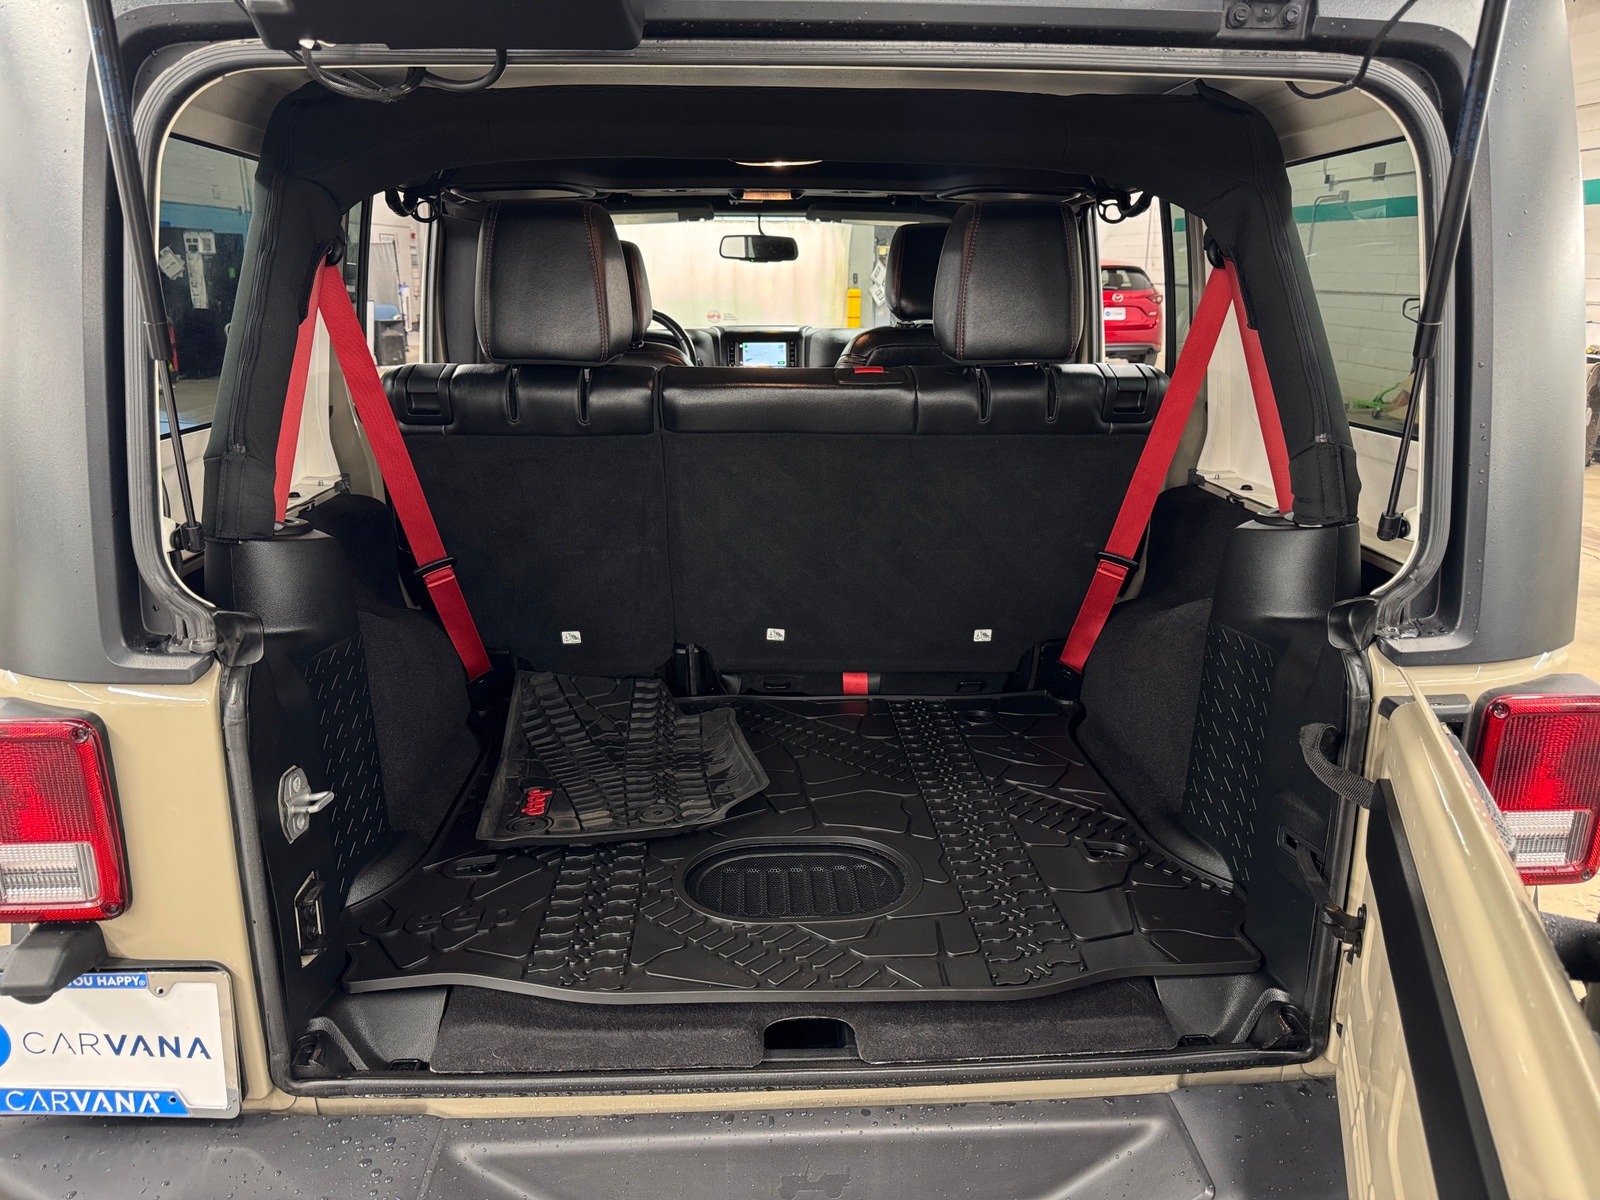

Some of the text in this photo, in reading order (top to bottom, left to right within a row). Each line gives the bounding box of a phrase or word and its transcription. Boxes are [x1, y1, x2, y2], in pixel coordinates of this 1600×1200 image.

[521, 788, 552, 816] Jeep
[359, 899, 522, 936] Jeep
[23, 1031, 212, 1060] CARVANA
